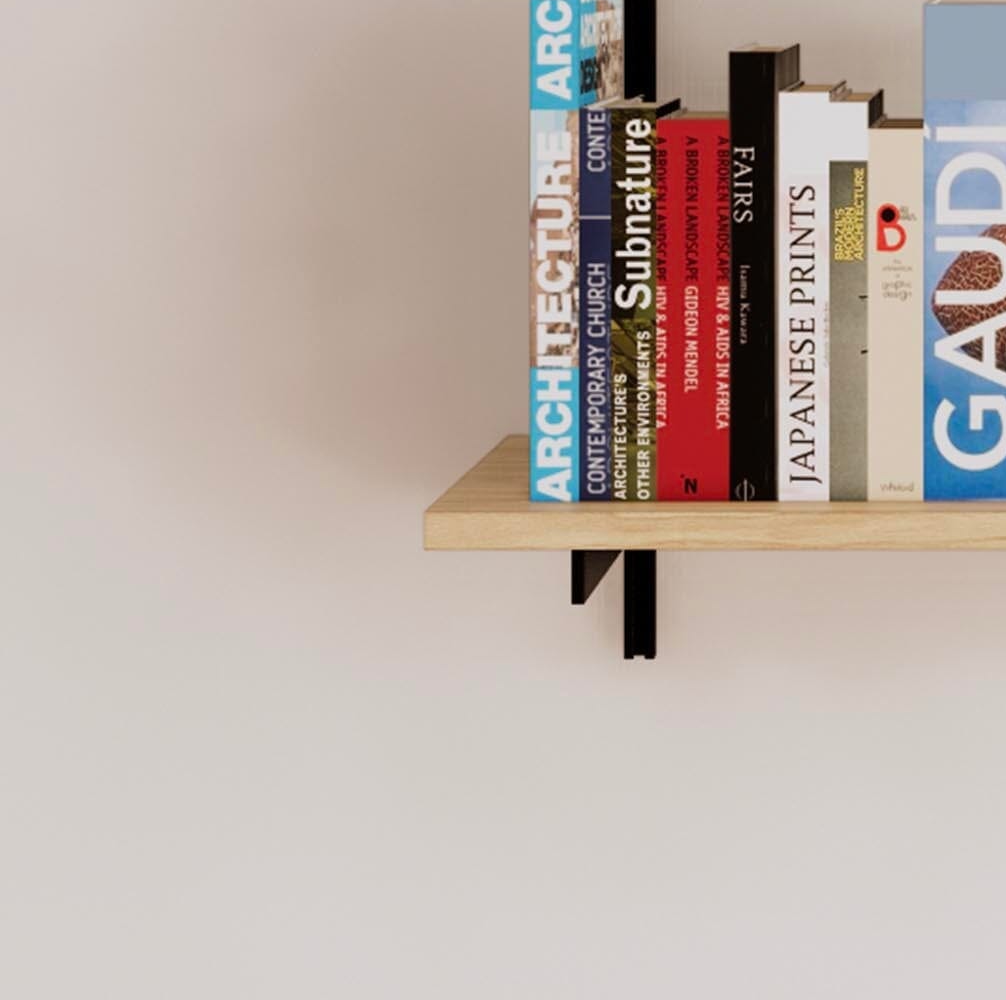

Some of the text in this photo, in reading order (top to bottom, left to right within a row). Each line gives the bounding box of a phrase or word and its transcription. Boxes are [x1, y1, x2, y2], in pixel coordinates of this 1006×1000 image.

[587, 107, 606, 173] CONTE
[656, 149, 668, 202] BROKEN
[614, 117, 652, 310] Subnature
[733, 146, 755, 224] FAIRS
[854, 168, 865, 261] ARCHITECTURE
[656, 206, 668, 281] LANDSCAPE
[684, 136, 699, 393] A BROKEN LANDSCAPE GIDEON MENDEL
[844, 206, 855, 261] MODERN
[535, 131, 573, 501] ARCHITECTURE
[656, 285, 667, 310] HIV
[716, 136, 730, 430] A BROKEN LANDSCAPE HIV & AIDS IN AFRICA
[656, 327, 667, 360] AIDS
[656, 362, 667, 378] IN
[789, 184, 822, 484] JAPANESE PRINTS
[587, 262, 606, 495] CONTEMPORARY CHURCH
[636, 330, 651, 500] OTHER ENVIRONMENTS
[656, 381, 667, 429] AFRICA
[613, 373, 628, 500] ARCHITECTURE'S
